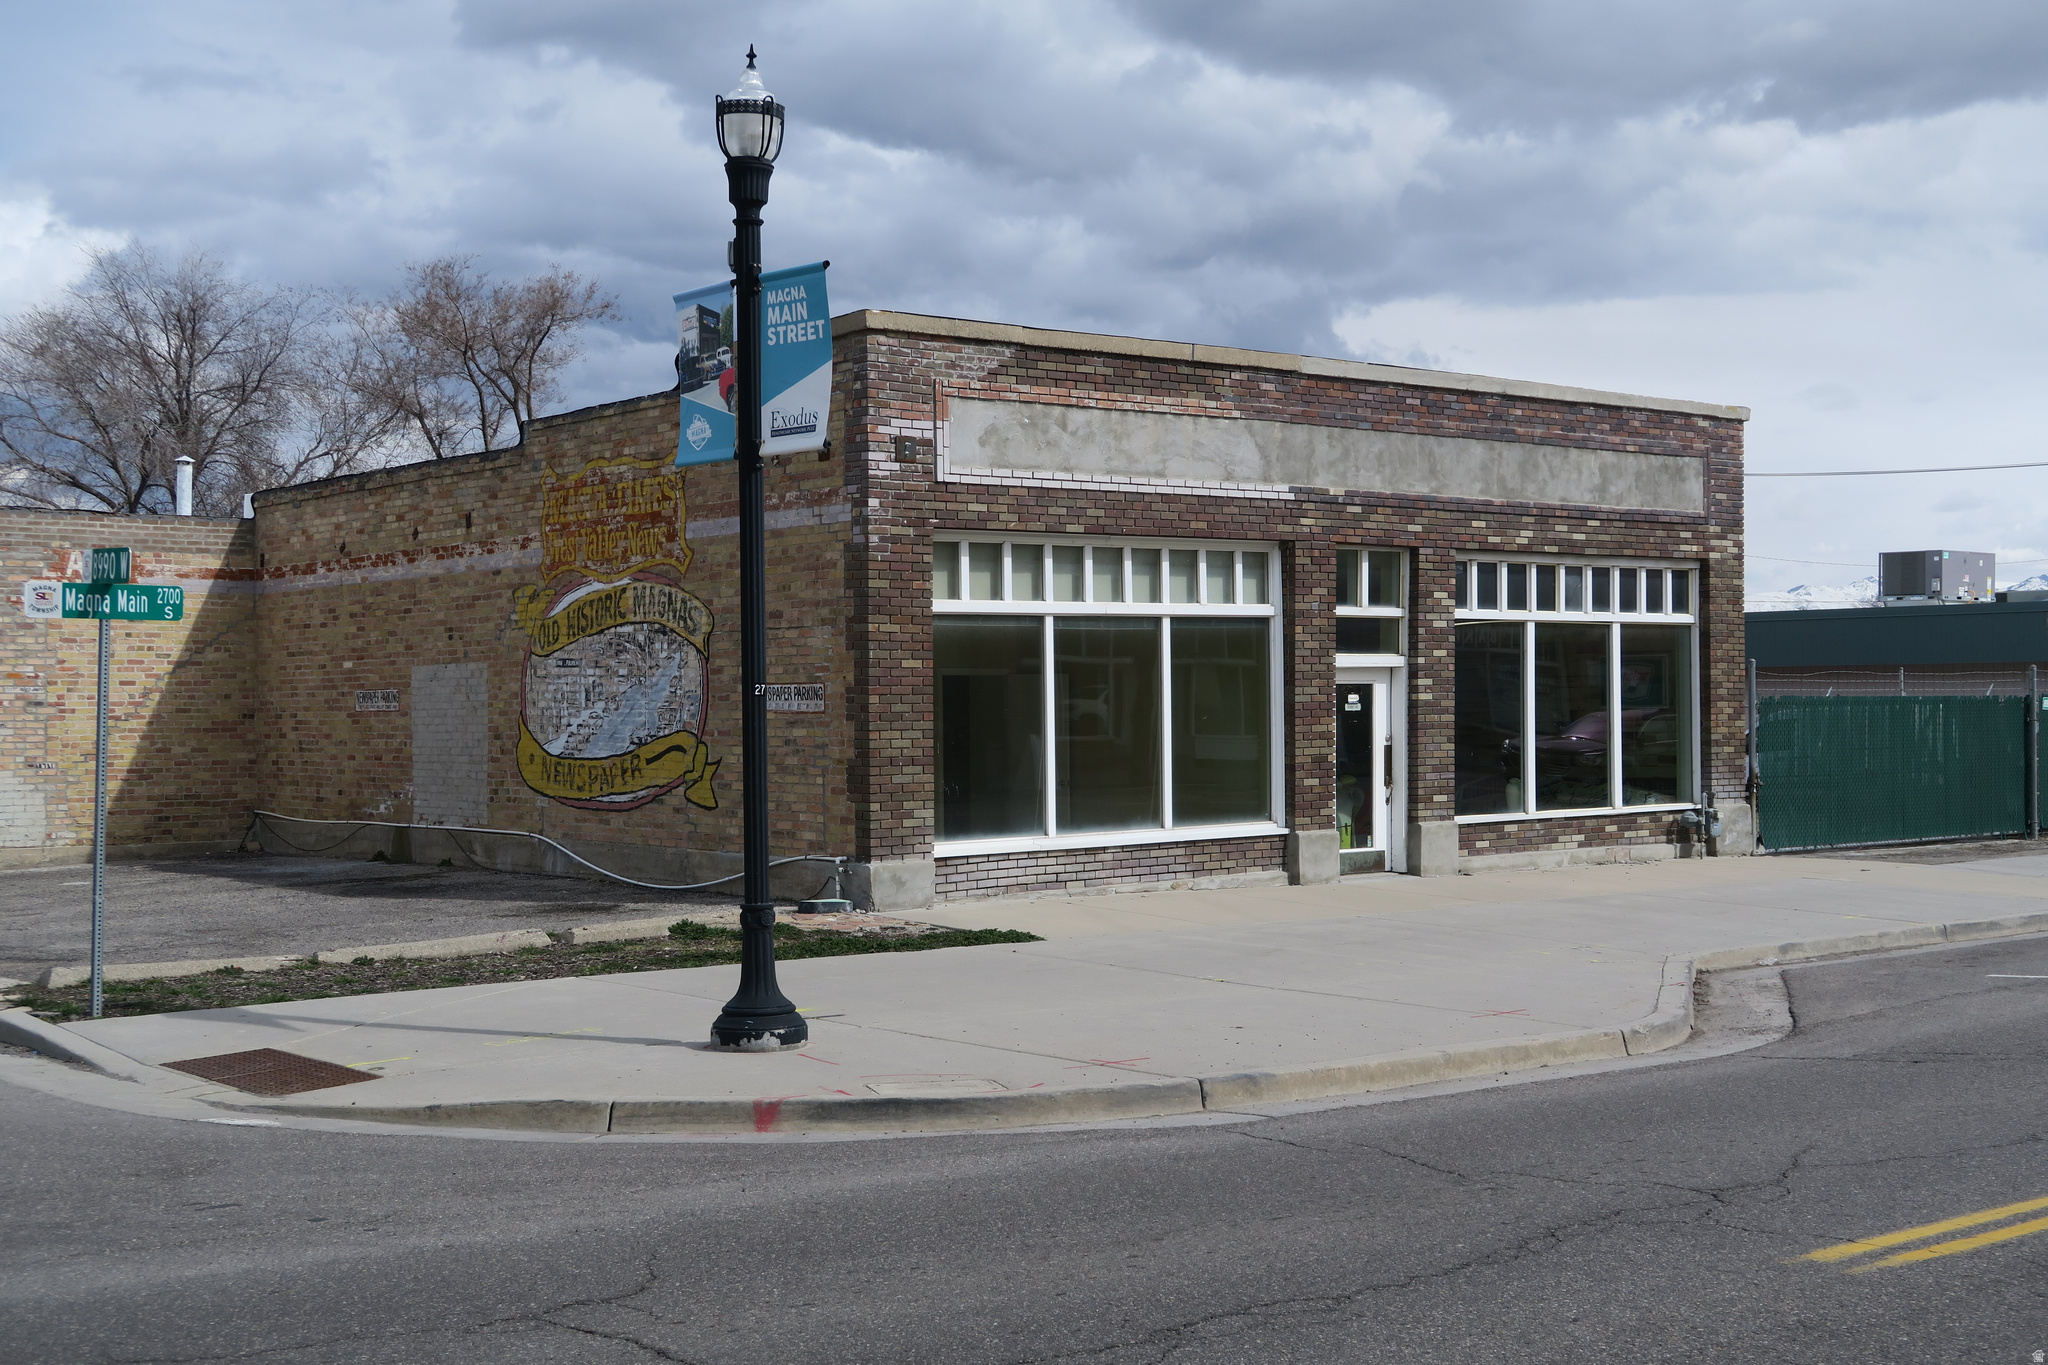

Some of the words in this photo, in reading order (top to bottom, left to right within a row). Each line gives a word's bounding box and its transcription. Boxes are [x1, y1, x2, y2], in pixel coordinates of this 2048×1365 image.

[767, 285, 807, 305] MAGNA
[767, 301, 808, 326] MAIN
[767, 319, 825, 346] STREET
[770, 406, 819, 429] Exodus
[581, 525, 626, 568] Valley
[627, 522, 668, 556] News
[93, 552, 117, 580] 8990
[120, 551, 129, 579] W
[29, 604, 60, 613] TOWNSHIP
[65, 588, 111, 618] Magna
[117, 590, 148, 613] Main
[157, 588, 181, 604] 2700
[164, 606, 174, 619] S
[538, 619, 560, 651] OLD
[567, 587, 627, 640] HISTORIC
[380, 690, 399, 703] PARKING
[755, 684, 766, 695] 27
[794, 686, 824, 701] PARKING
[541, 754, 642, 793] NEWSPAPER
